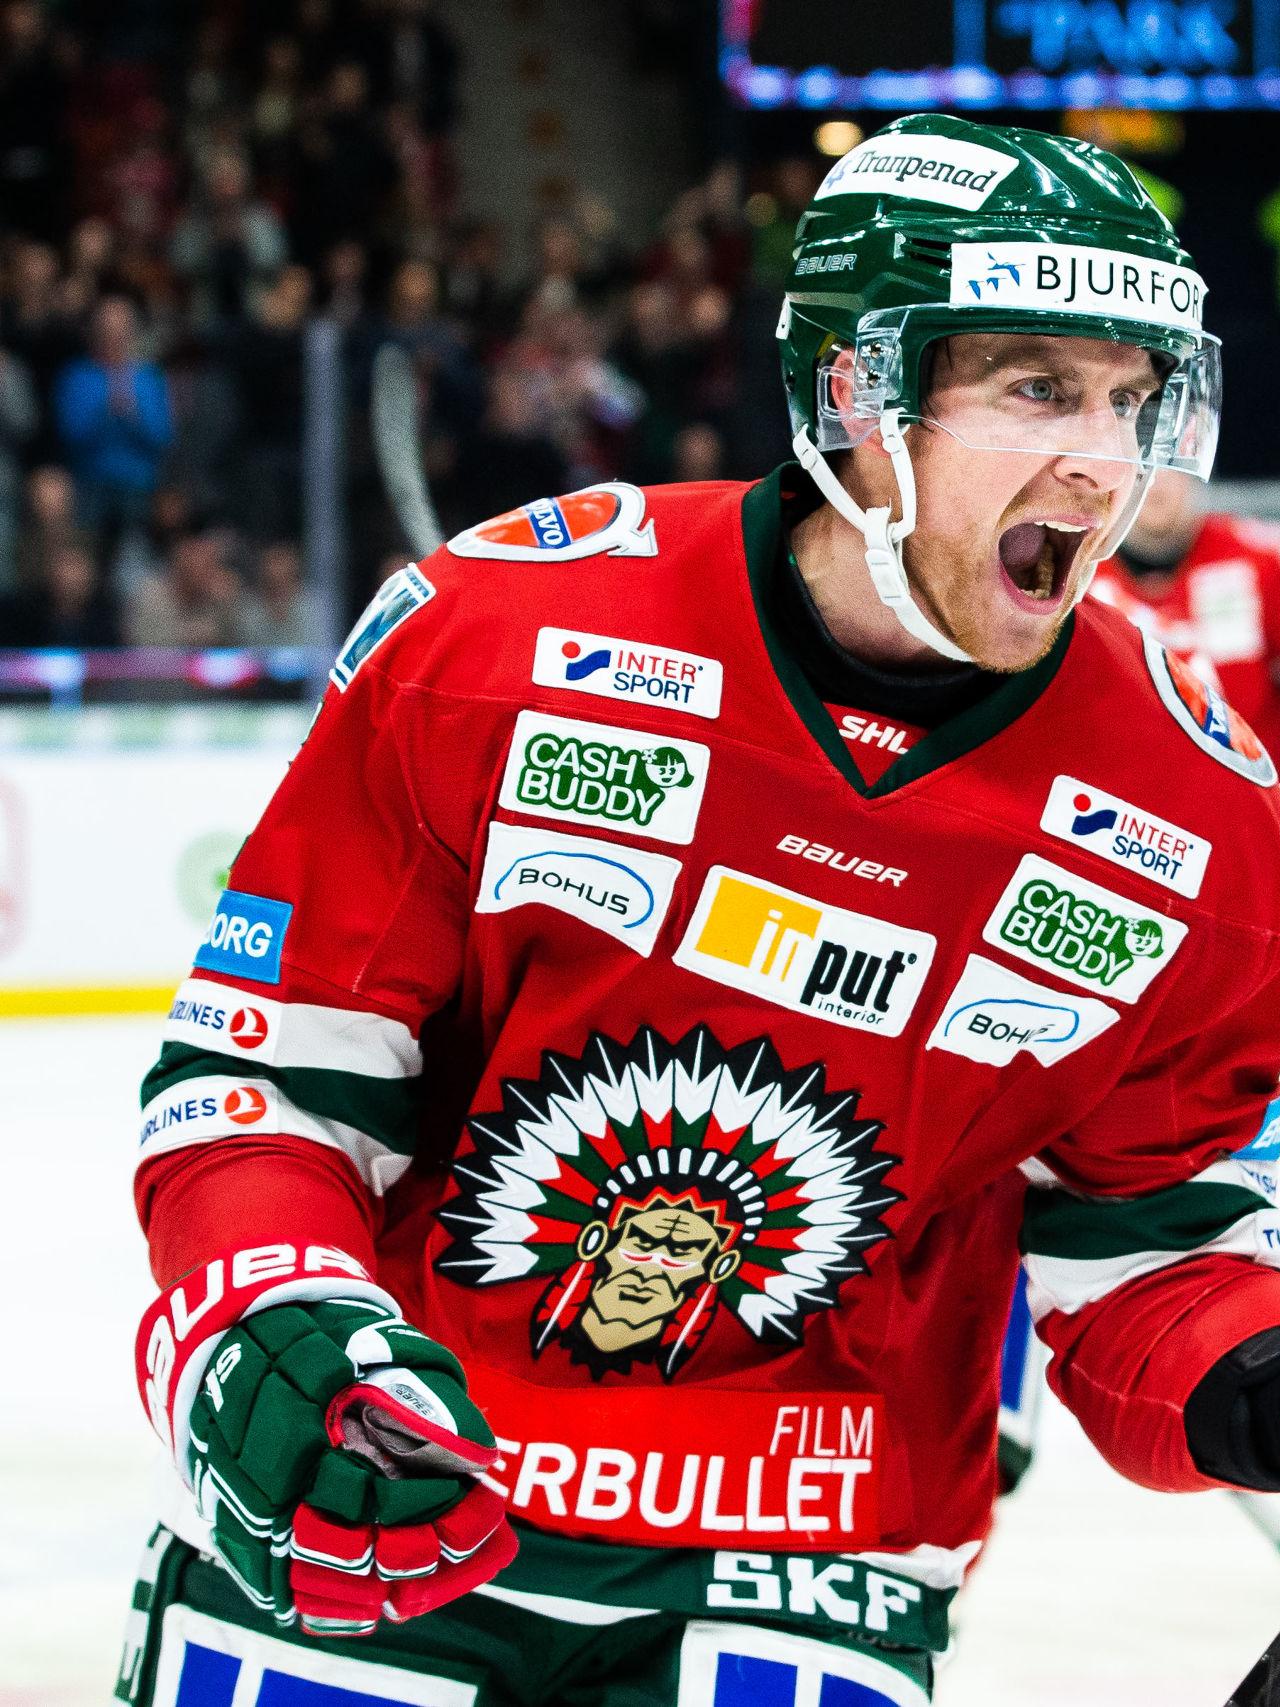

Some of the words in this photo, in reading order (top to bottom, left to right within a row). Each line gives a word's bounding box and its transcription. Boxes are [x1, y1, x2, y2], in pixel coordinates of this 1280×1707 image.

[852, 150, 998, 194] Tranpenad
[613, 671, 695, 704] SPORT
[617, 649, 698, 684] INTER
[838, 714, 909, 755] SHL
[528, 737, 637, 785] CASH
[520, 773, 662, 824] BUDDY
[776, 834, 909, 888] BAUER
[1112, 834, 1182, 880] SPORT
[1120, 812, 1188, 861] INTER
[518, 868, 631, 916] BOHUS
[1022, 883, 1122, 948] CASH
[749, 909, 908, 1013] input
[1005, 912, 1134, 984] BUDDY
[769, 1405, 874, 1458] FILM
[706, 1550, 921, 1632] SKF
